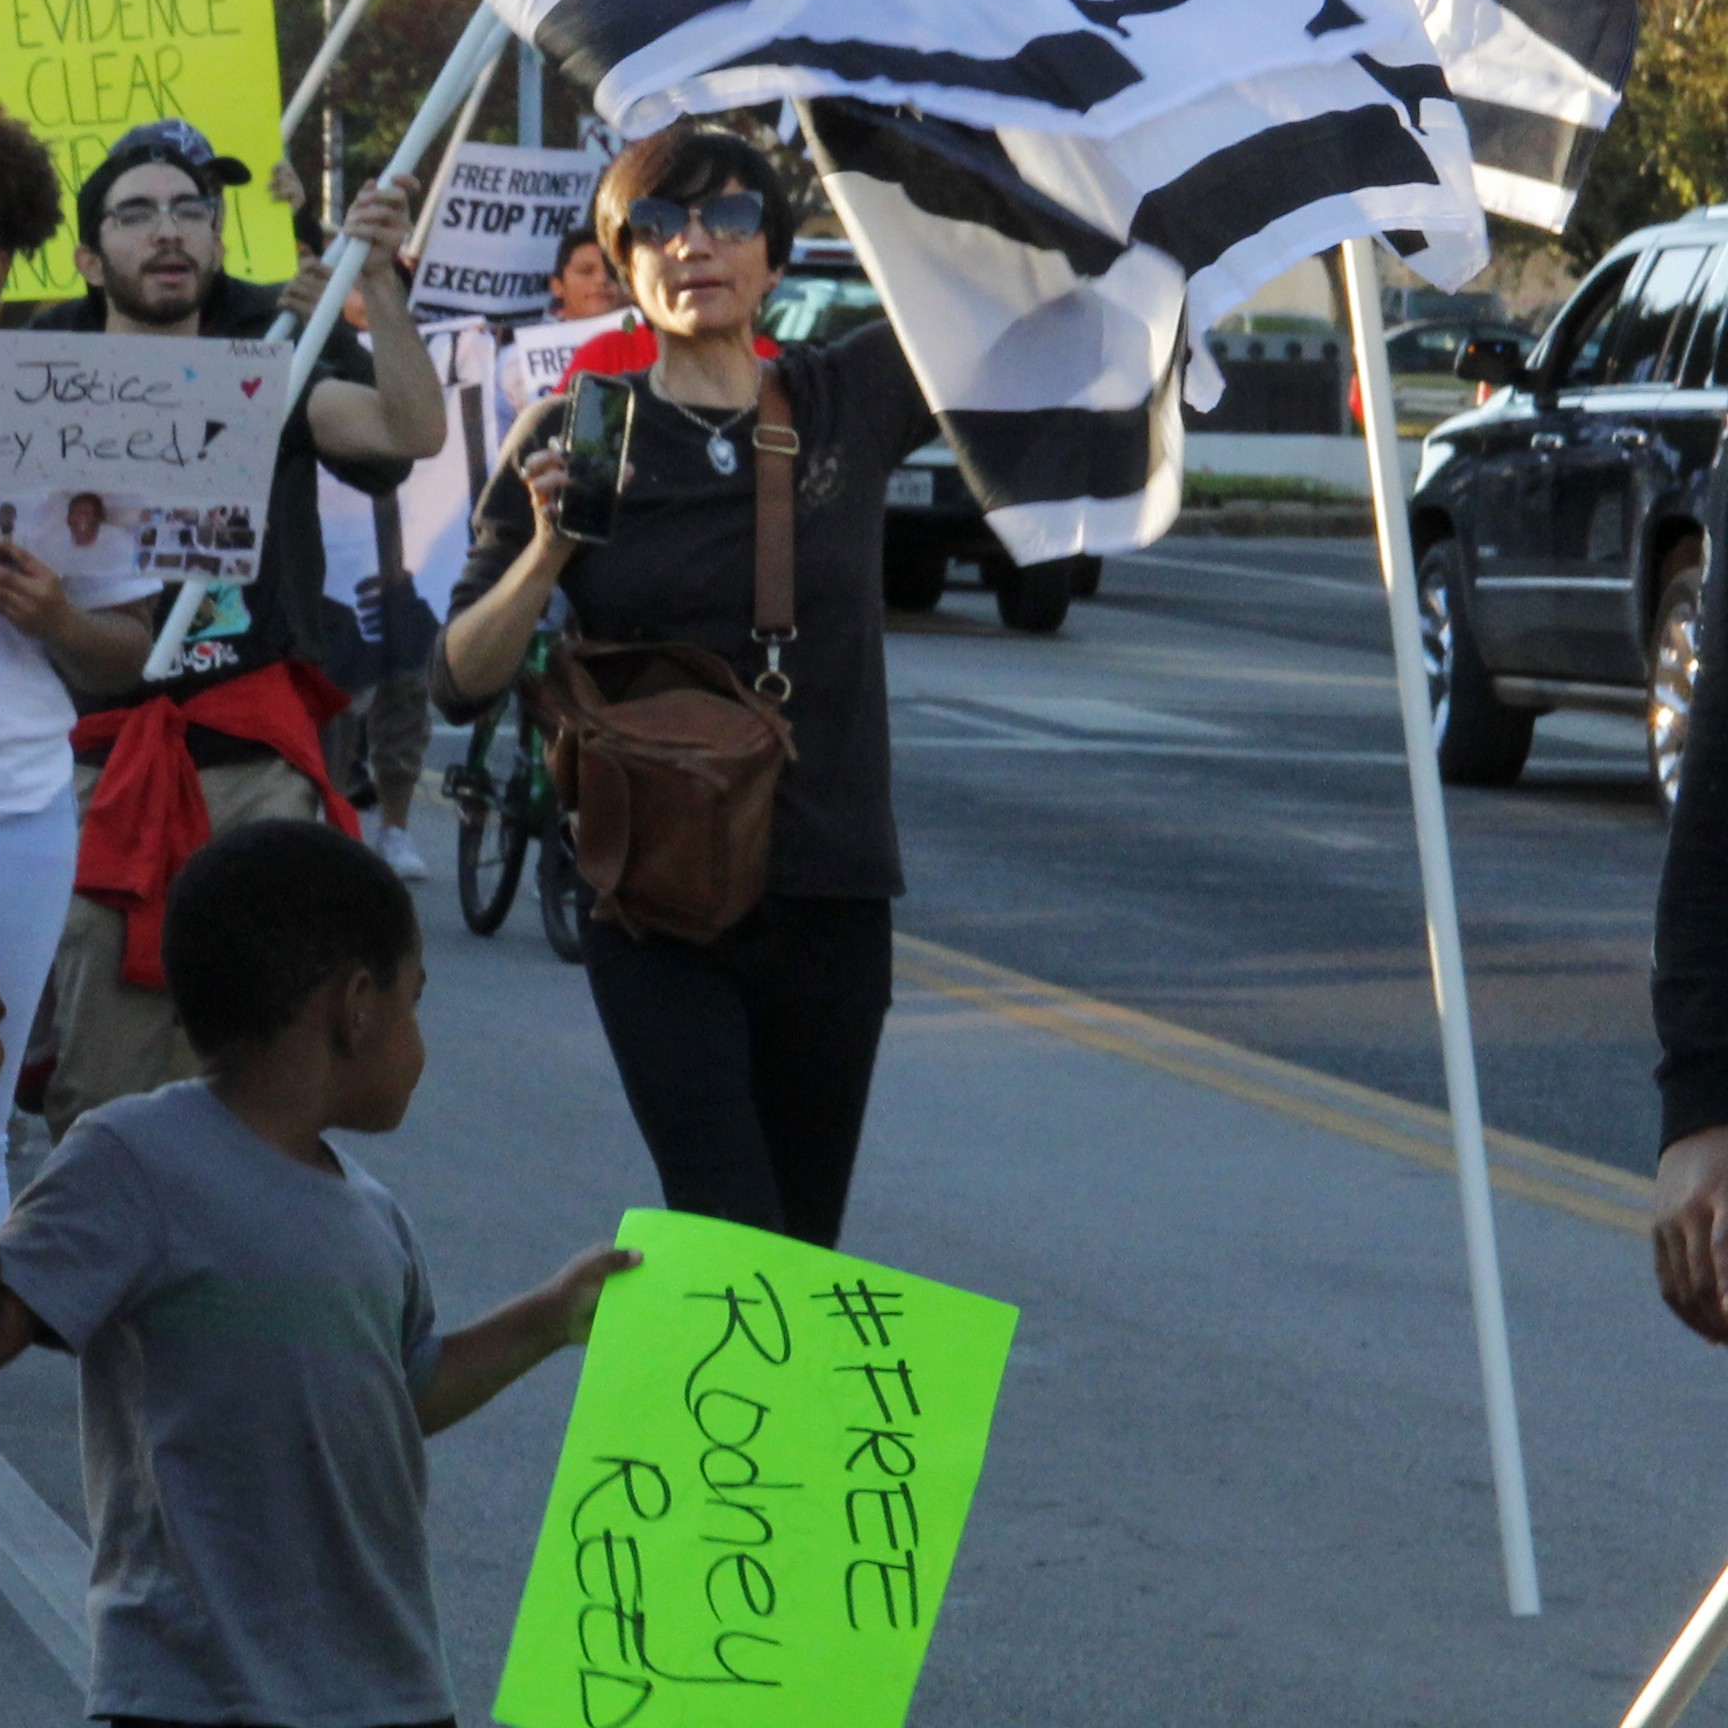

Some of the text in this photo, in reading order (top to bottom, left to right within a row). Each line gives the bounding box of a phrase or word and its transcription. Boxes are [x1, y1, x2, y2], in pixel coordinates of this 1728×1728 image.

[26, 44, 186, 128] CLEAR
[450, 163, 592, 198] FREE RODNEY!
[442, 197, 581, 238] STOP THE
[527, 345, 578, 378] FRE
[809, 1278, 921, 1630] #FREE
